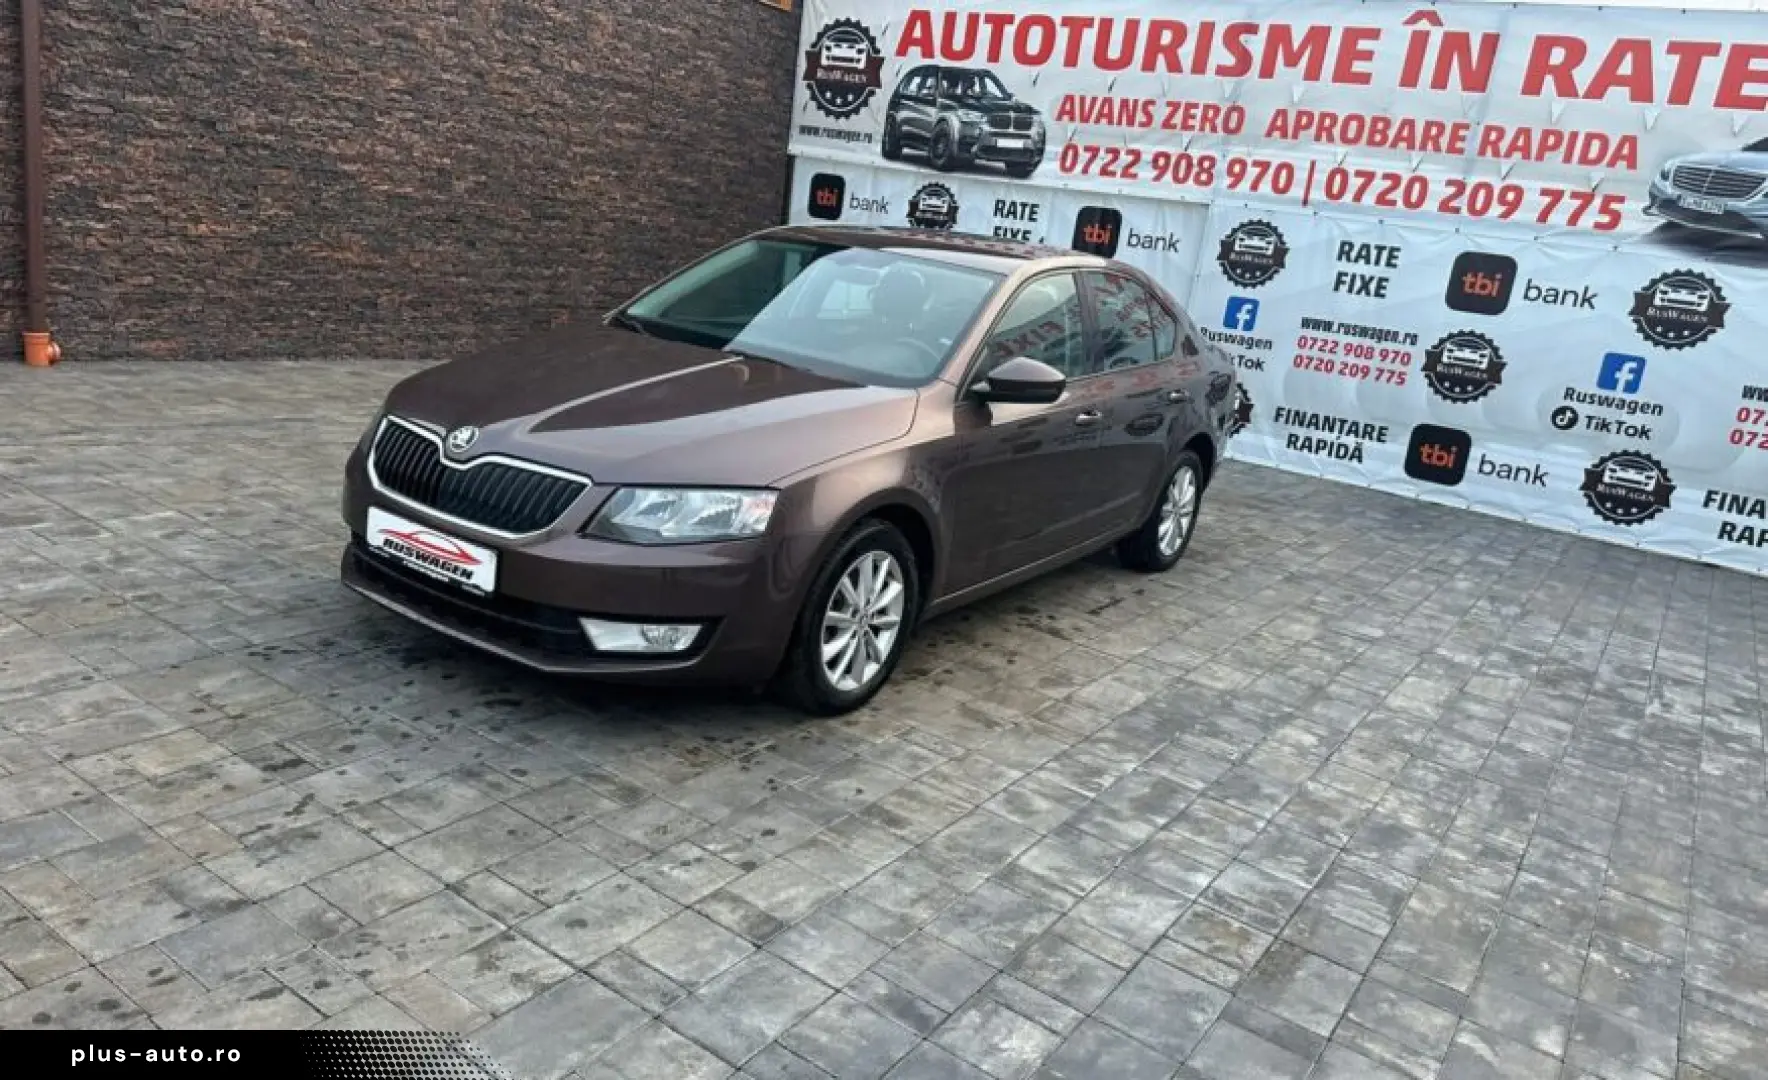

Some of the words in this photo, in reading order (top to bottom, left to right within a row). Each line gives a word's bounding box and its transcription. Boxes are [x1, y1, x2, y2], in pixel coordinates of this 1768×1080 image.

[895, 9, 1381, 86] AUTOTURISME
[1399, 10, 1500, 93] ÎN
[1521, 35, 1768, 111] RATE
[1055, 94, 1156, 128] AVANS
[1162, 101, 1246, 135] ZERO
[1265, 108, 1471, 155] APROBARE
[1477, 124, 1639, 170] RAPIDA
[815, 187, 839, 208] tbi
[849, 193, 889, 215] bank
[1059, 144, 1142, 179] 0722
[1151, 150, 1217, 187] 908
[1226, 157, 1296, 194] 970
[1324, 167, 1430, 211] 0720
[1437, 179, 1525, 220] 209
[1536, 188, 1626, 231] 775
[993, 199, 1040, 222] RATE
[1083, 224, 1112, 246] tbi
[1127, 227, 1180, 253] bank
[1336, 240, 1402, 269] RATE
[1332, 271, 1390, 299] FIXE
[1461, 271, 1502, 298] tbi
[1523, 278, 1598, 310] bank
[1301, 316, 1419, 346] www.ruswagen.ro
[1297, 334, 1339, 354] 0722
[1343, 342, 1375, 360] 908
[1379, 348, 1412, 366] 970
[1293, 354, 1335, 373] 0720
[1338, 360, 1371, 379] 209
[1374, 367, 1408, 386] 775
[1563, 386, 1664, 417] Ruswagen
[1585, 415, 1652, 440] TikTok
[1286, 433, 1364, 464] RAPIDĂ
[1419, 442, 1457, 469] tbi
[1477, 453, 1550, 488] bank
[1702, 489, 1766, 520] FINA
[383, 538, 474, 580] RUSWAGEN
